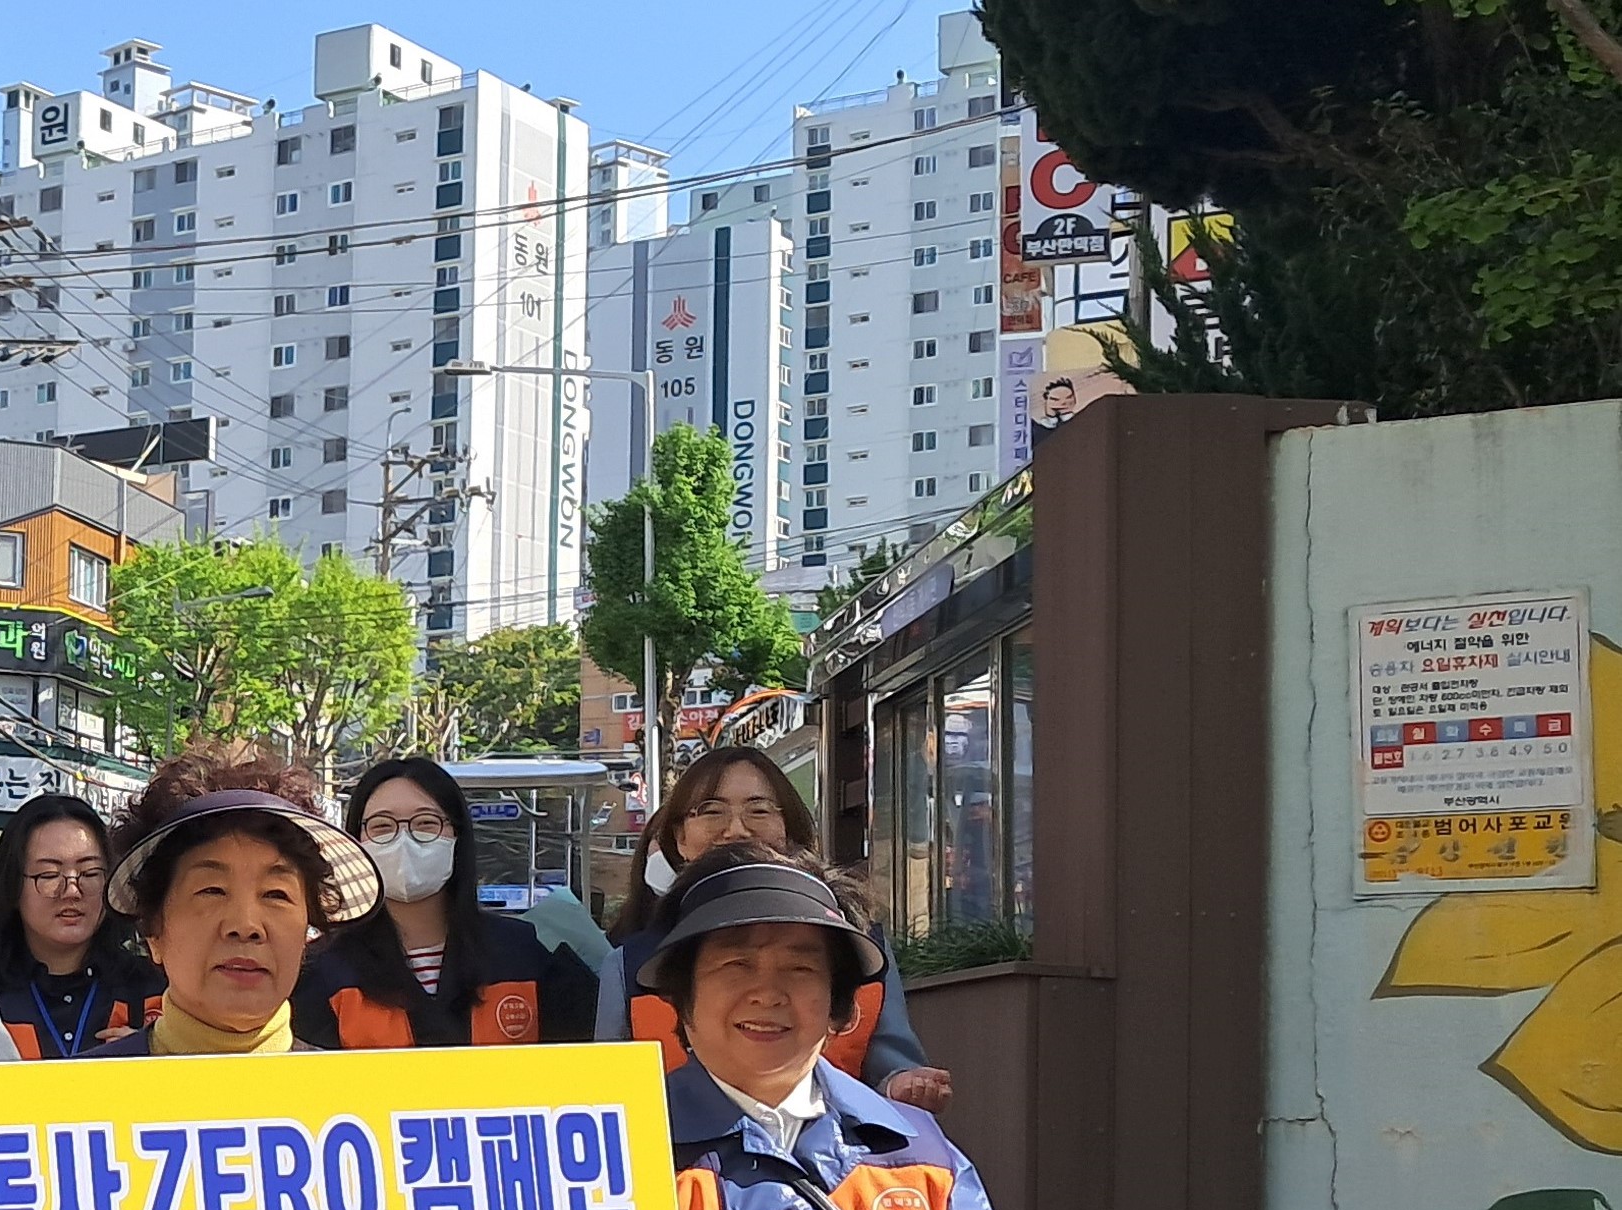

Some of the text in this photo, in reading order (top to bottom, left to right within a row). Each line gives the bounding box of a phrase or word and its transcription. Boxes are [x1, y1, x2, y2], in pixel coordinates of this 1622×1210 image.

[40, 102, 69, 146] 원
[1053, 219, 1076, 236] 2F
[1025, 235, 1105, 256] 부산만덕점
[1003, 272, 1038, 284] CAFE
[519, 291, 541, 321] 101
[660, 377, 696, 398] 105
[560, 349, 579, 550] DONGWON
[1368, 615, 1459, 636] 계획보다는
[1406, 632, 1530, 654] 에너지 절약을 위한
[1506, 648, 1571, 667] 실시안내
[1478, 723, 1493, 736] 수
